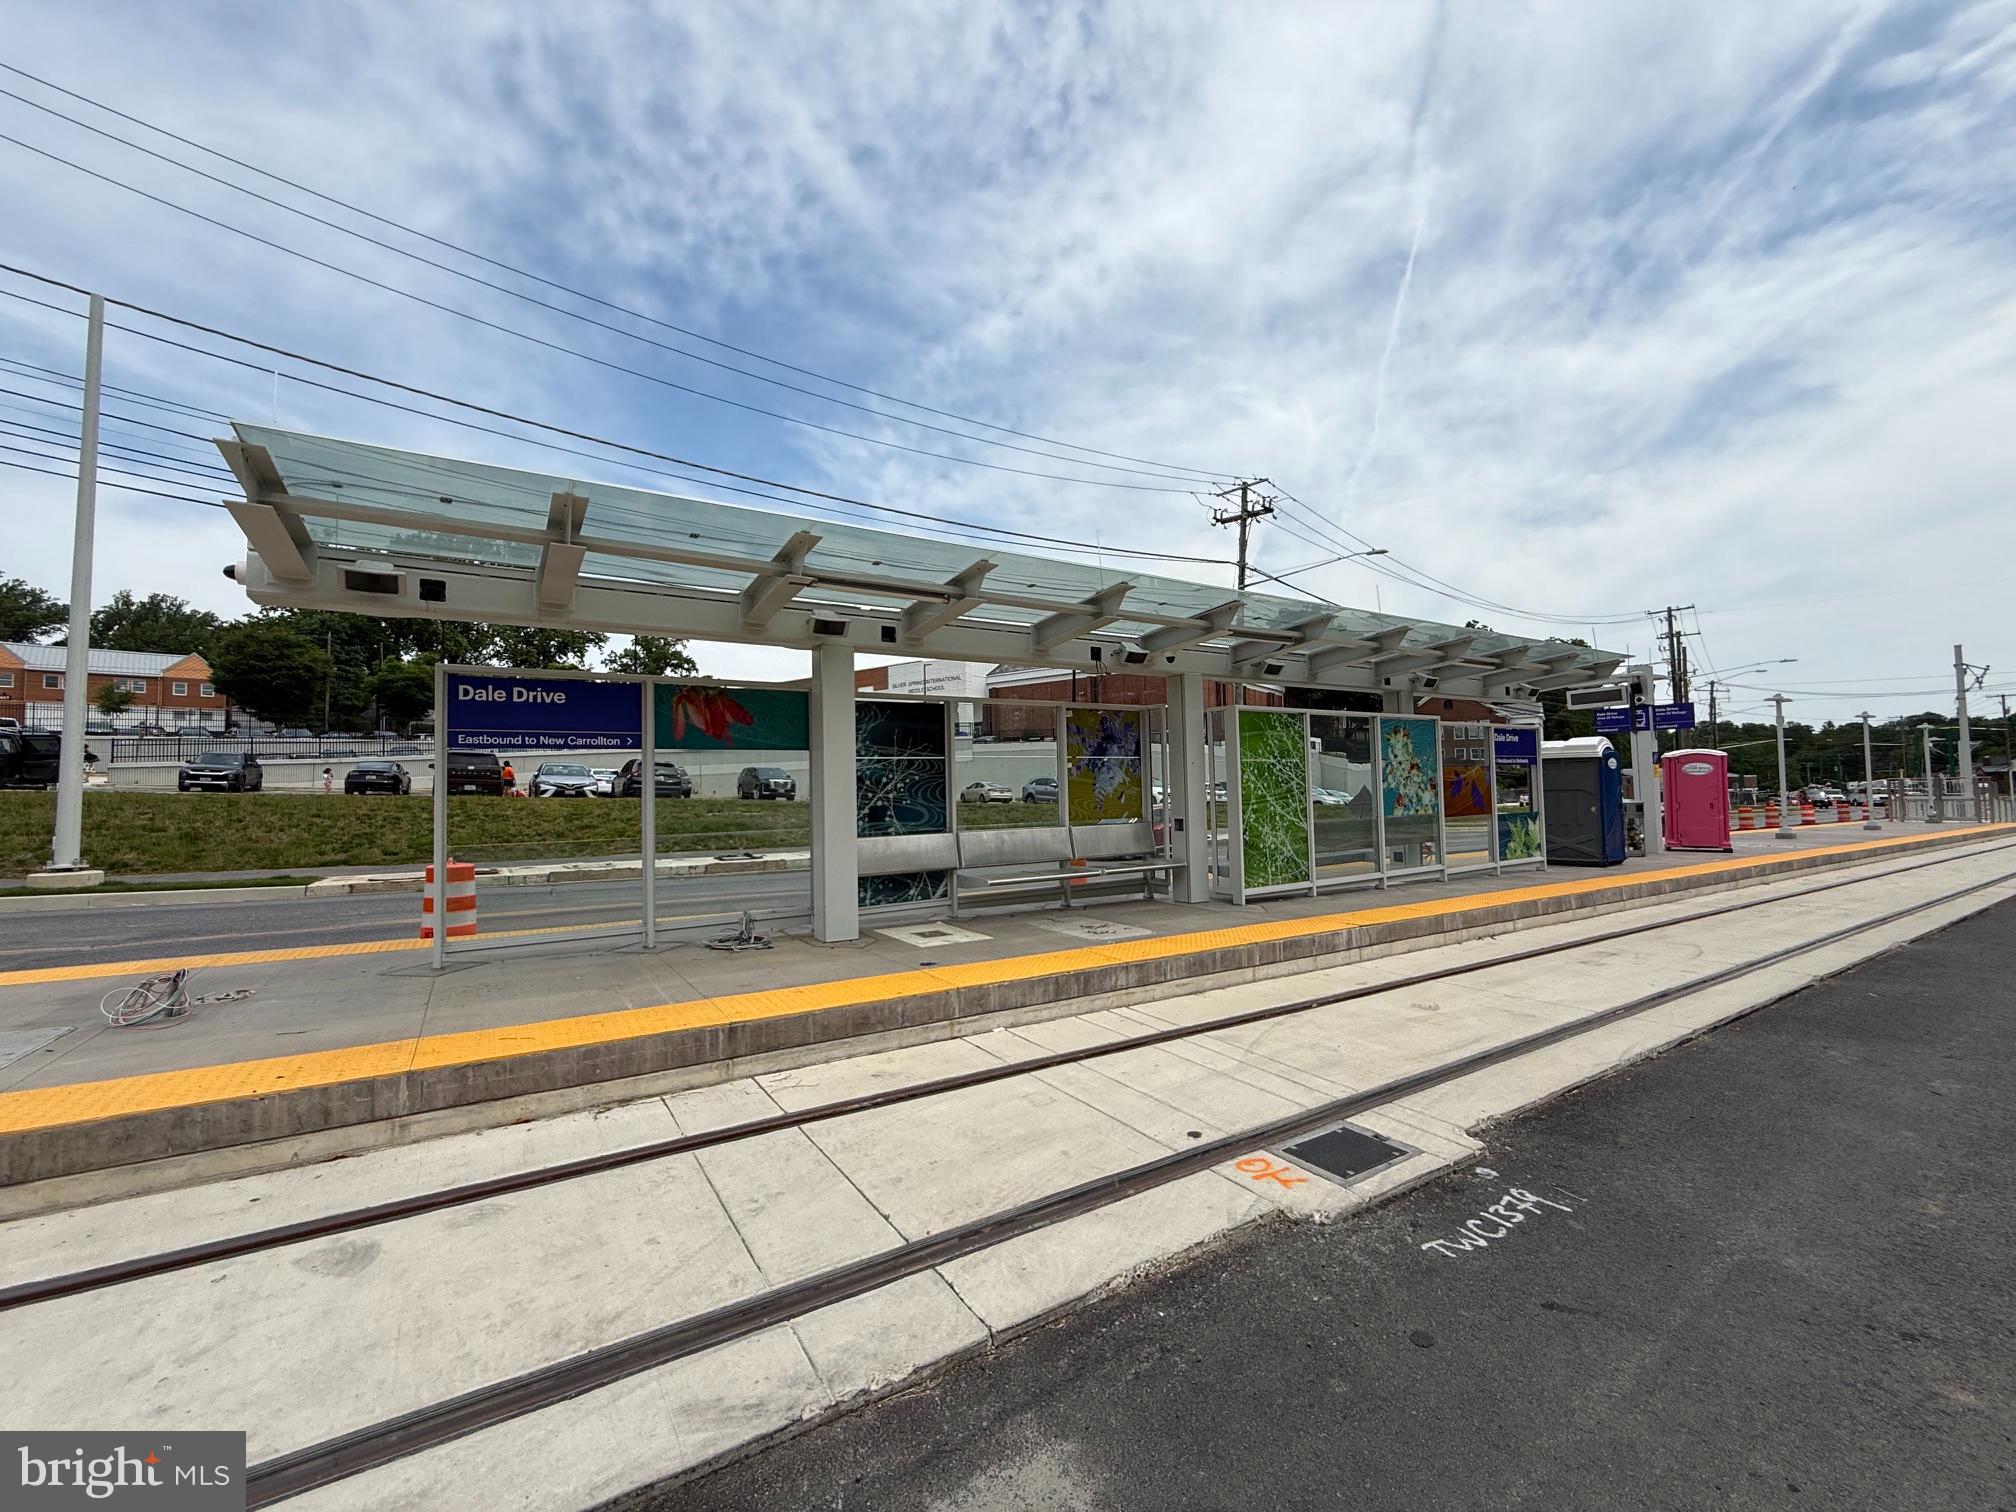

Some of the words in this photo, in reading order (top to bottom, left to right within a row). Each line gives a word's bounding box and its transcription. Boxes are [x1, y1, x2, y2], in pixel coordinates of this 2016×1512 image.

[458, 684, 507, 702] Dale
[512, 686, 566, 704] Drive
[458, 734, 522, 746] Eastbound
[525, 736, 536, 746] to
[540, 736, 566, 746] New
[568, 736, 621, 746] Carrollton
[1494, 733, 1505, 742] Dale
[1506, 734, 1519, 742] Drive
